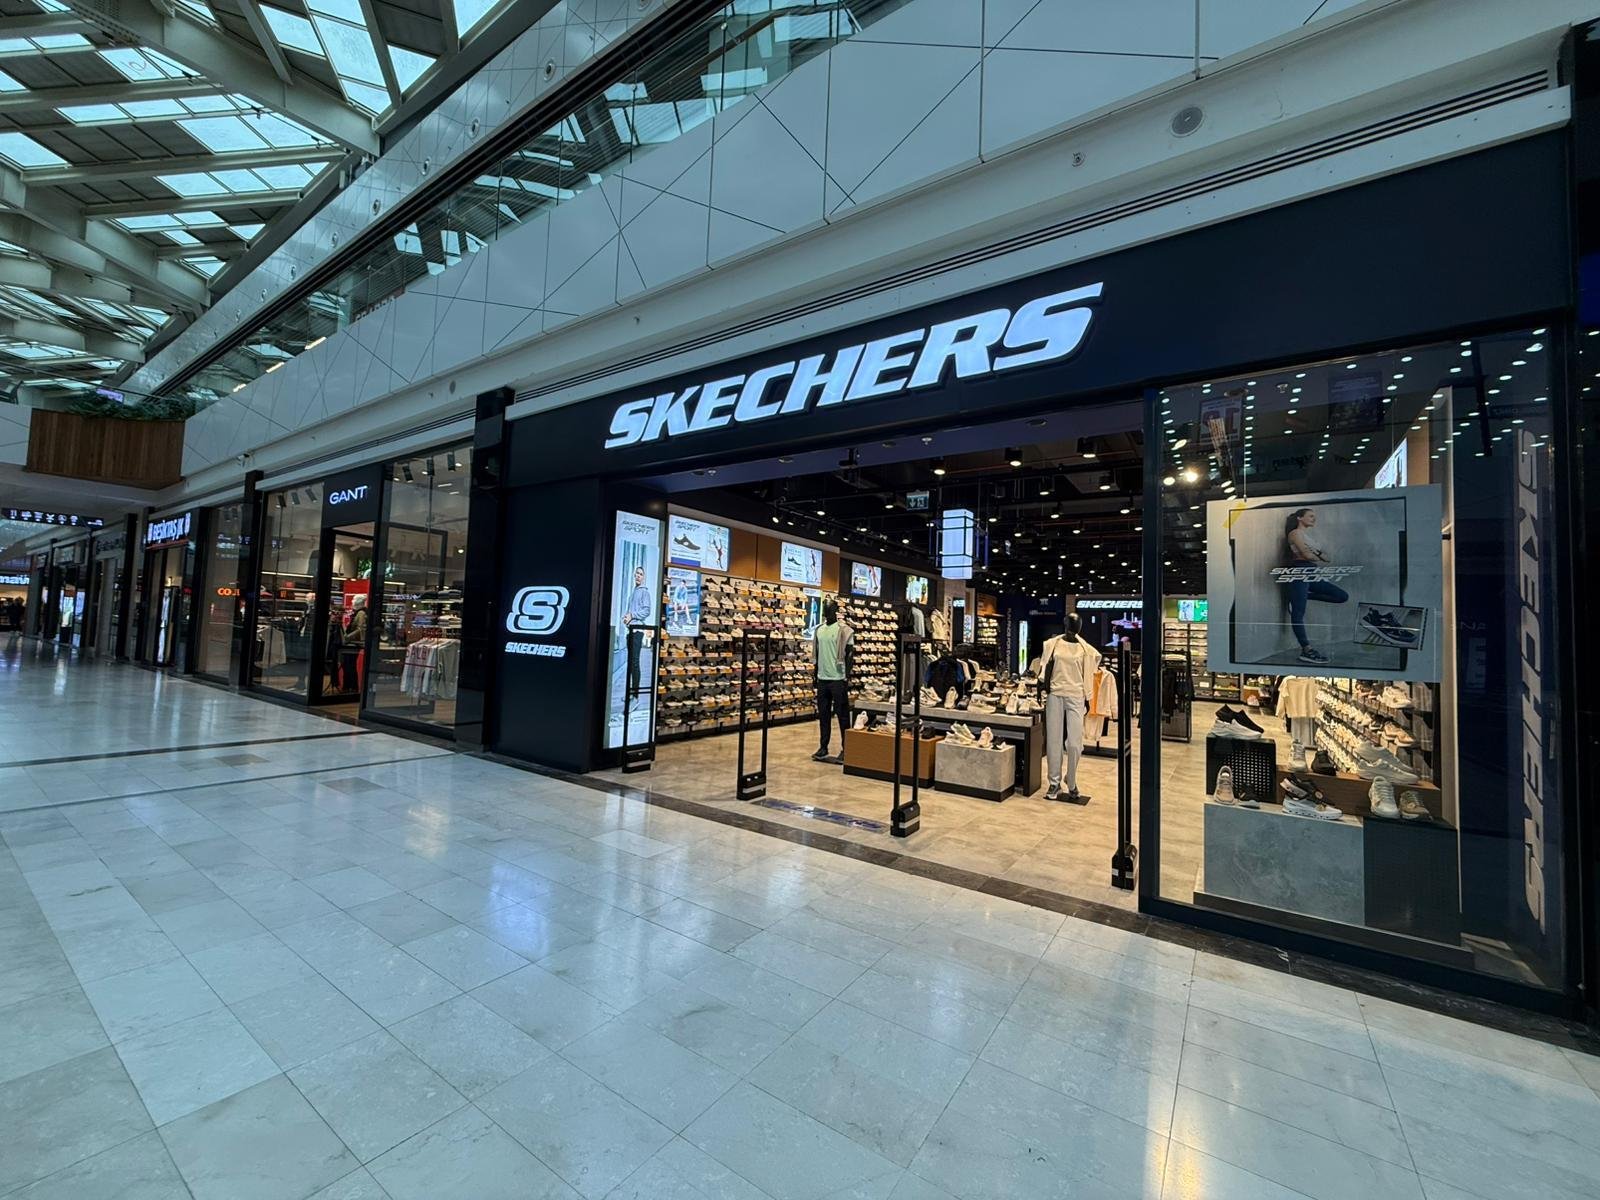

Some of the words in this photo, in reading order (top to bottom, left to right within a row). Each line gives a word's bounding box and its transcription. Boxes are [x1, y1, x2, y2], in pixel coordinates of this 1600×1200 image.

[604, 281, 1104, 449] SKECHERS
[329, 485, 368, 505] GANT
[1269, 565, 1364, 575] SKECHERS
[1275, 573, 1350, 583] SPORT
[505, 641, 566, 657] SKECHERS
[1516, 428, 1546, 936] SKECHERS
